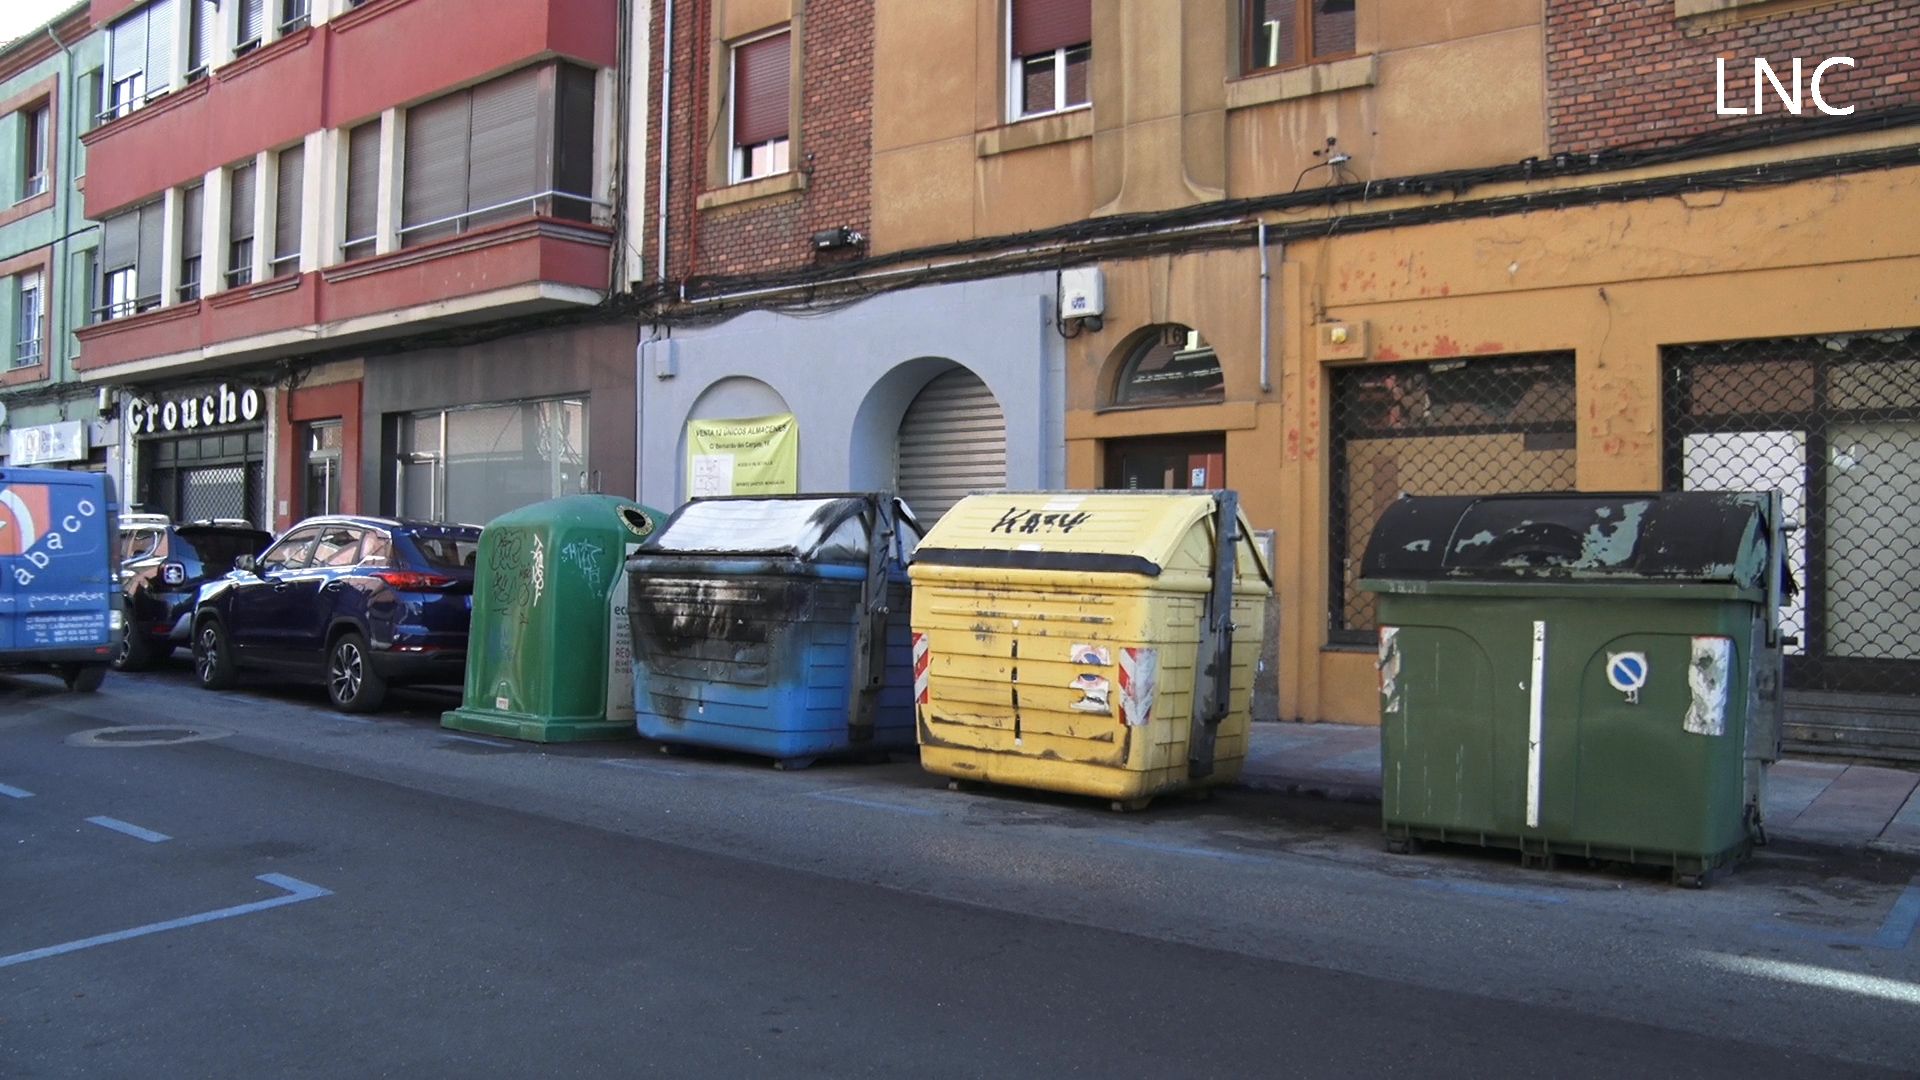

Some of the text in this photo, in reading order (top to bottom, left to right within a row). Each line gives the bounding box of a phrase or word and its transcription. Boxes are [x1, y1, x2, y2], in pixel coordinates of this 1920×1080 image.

[128, 383, 258, 434] Groucho
[696, 429, 713, 437] VENTA
[10, 500, 95, 586] ábaco
